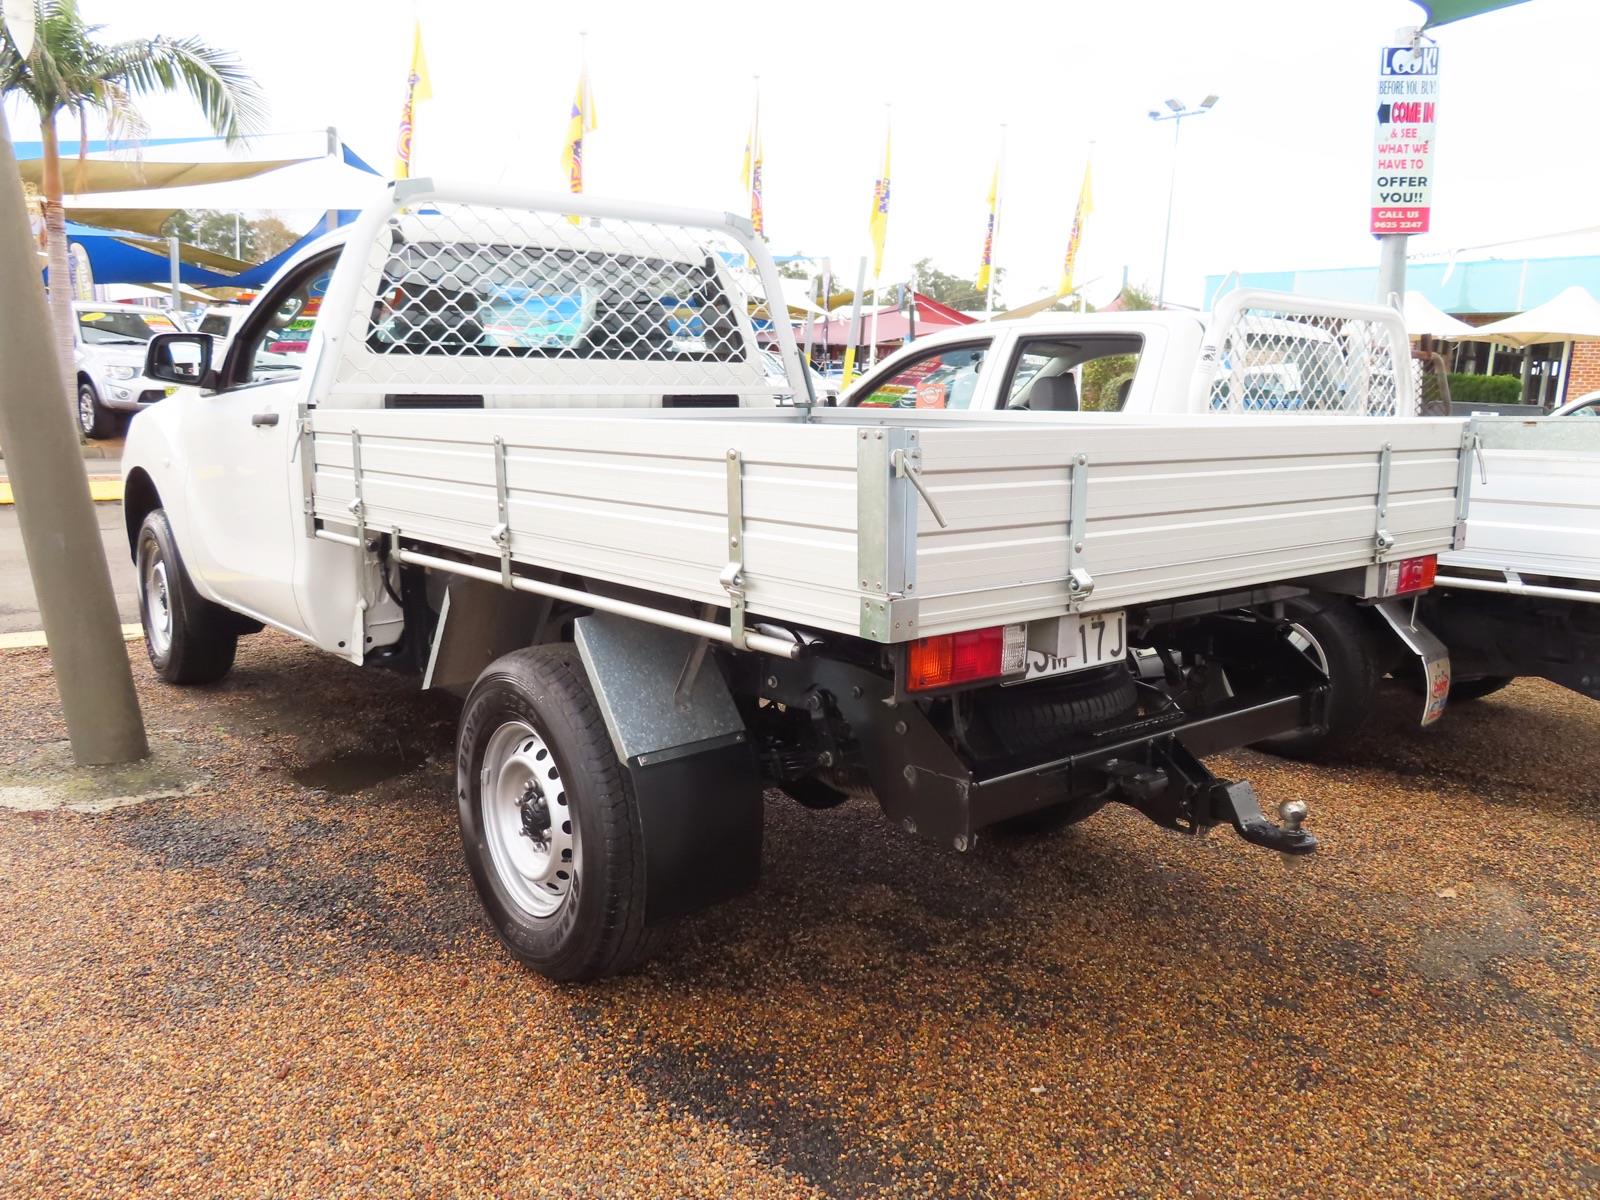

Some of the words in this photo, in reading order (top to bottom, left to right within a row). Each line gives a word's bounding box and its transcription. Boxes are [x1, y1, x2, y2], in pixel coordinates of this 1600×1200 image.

[1382, 48, 1438, 74] LOOK!
[1379, 81, 1404, 94] BEFORE
[1406, 81, 1418, 94] YOU
[1392, 102, 1421, 123] COME
[1423, 102, 1435, 123] IN
[1391, 129, 1398, 138] &
[1401, 128, 1417, 138] SEE
[1378, 144, 1409, 153] WHAT
[1412, 144, 1428, 153] WE
[1378, 160, 1407, 169] HAVE
[1410, 159, 1424, 169] TO
[1377, 176, 1428, 187] OFFER
[1380, 193, 1422, 202] YOU!!
